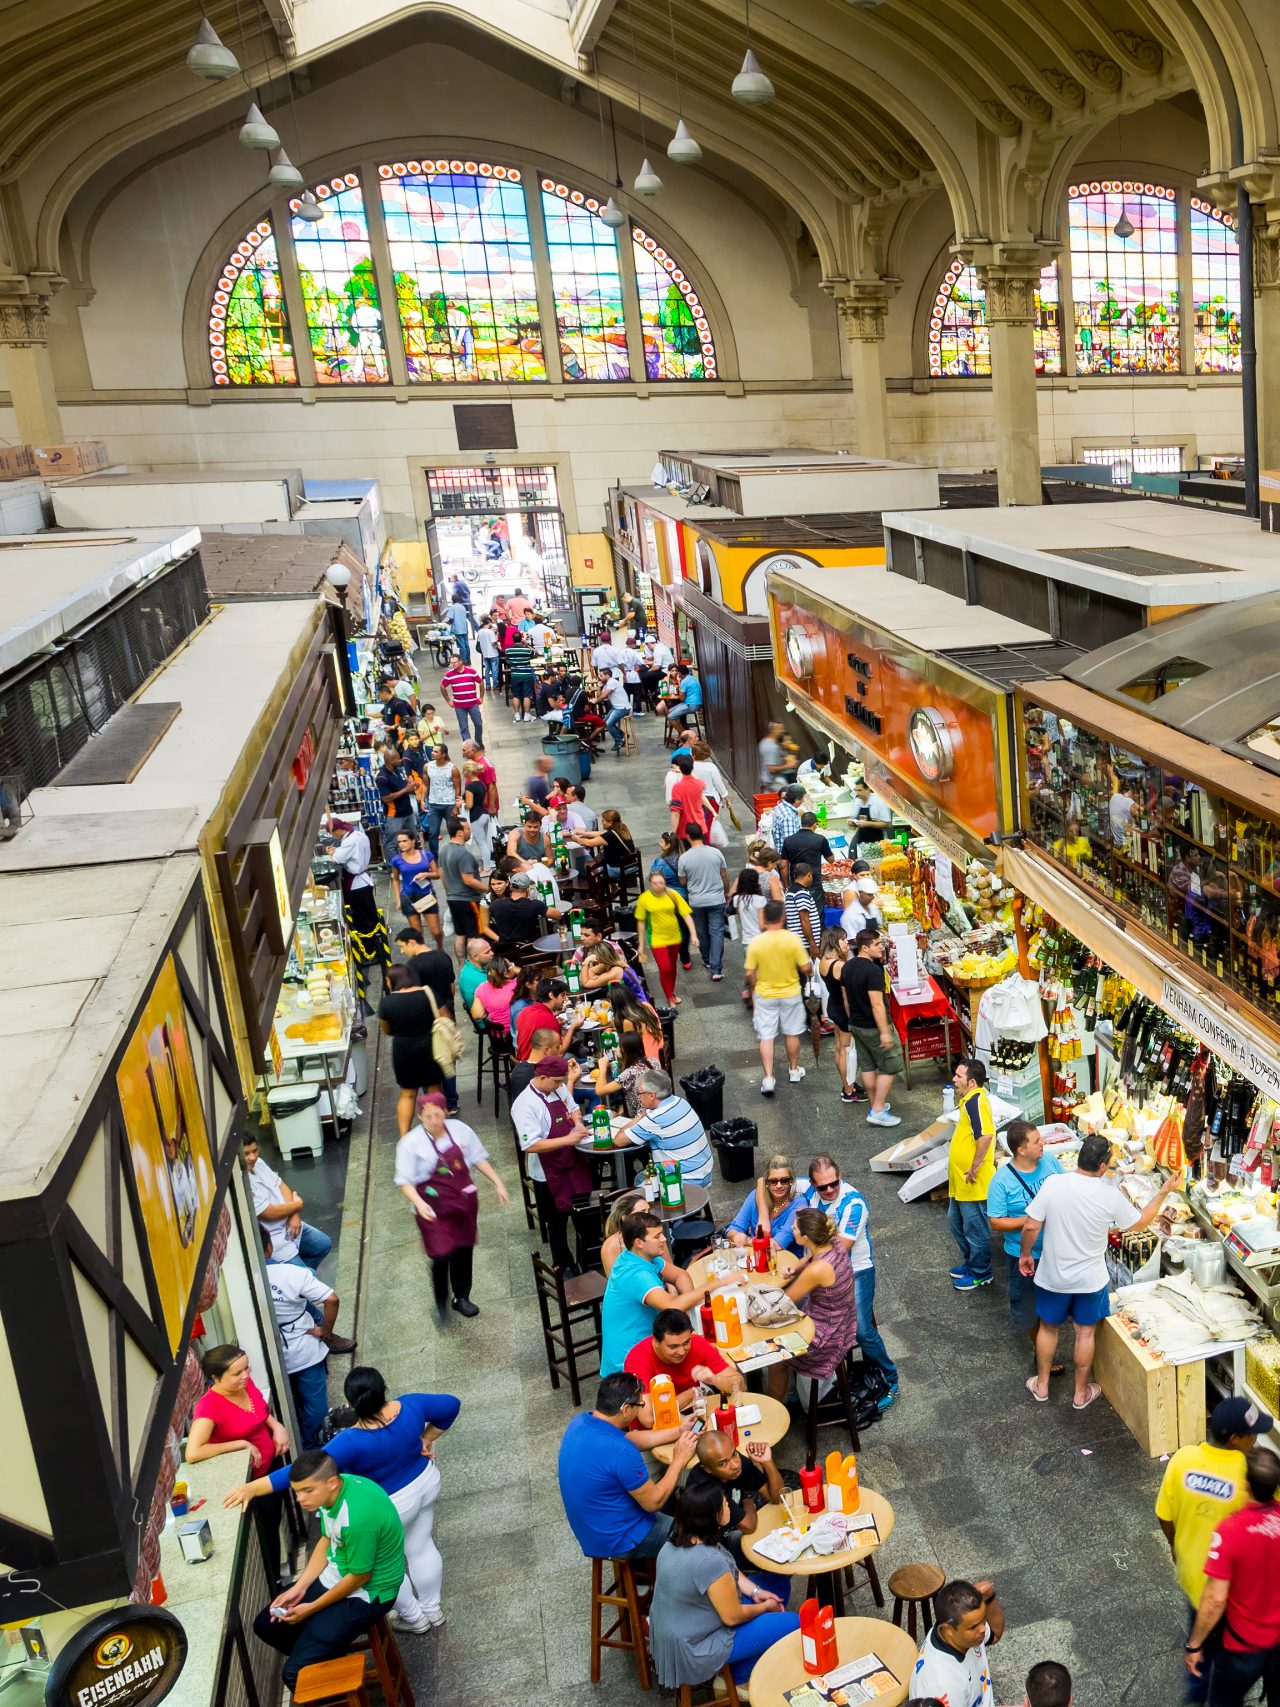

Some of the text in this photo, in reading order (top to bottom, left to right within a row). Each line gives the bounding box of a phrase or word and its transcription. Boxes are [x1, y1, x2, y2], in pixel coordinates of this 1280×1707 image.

[1164, 982, 1197, 1024] VENHAM
[1198, 1010, 1238, 1057] CONFERIR
[1239, 1045, 1247, 1064] A
[1249, 1054, 1279, 1088] SUPER
[77, 1646, 165, 1707] EISENBAHN
